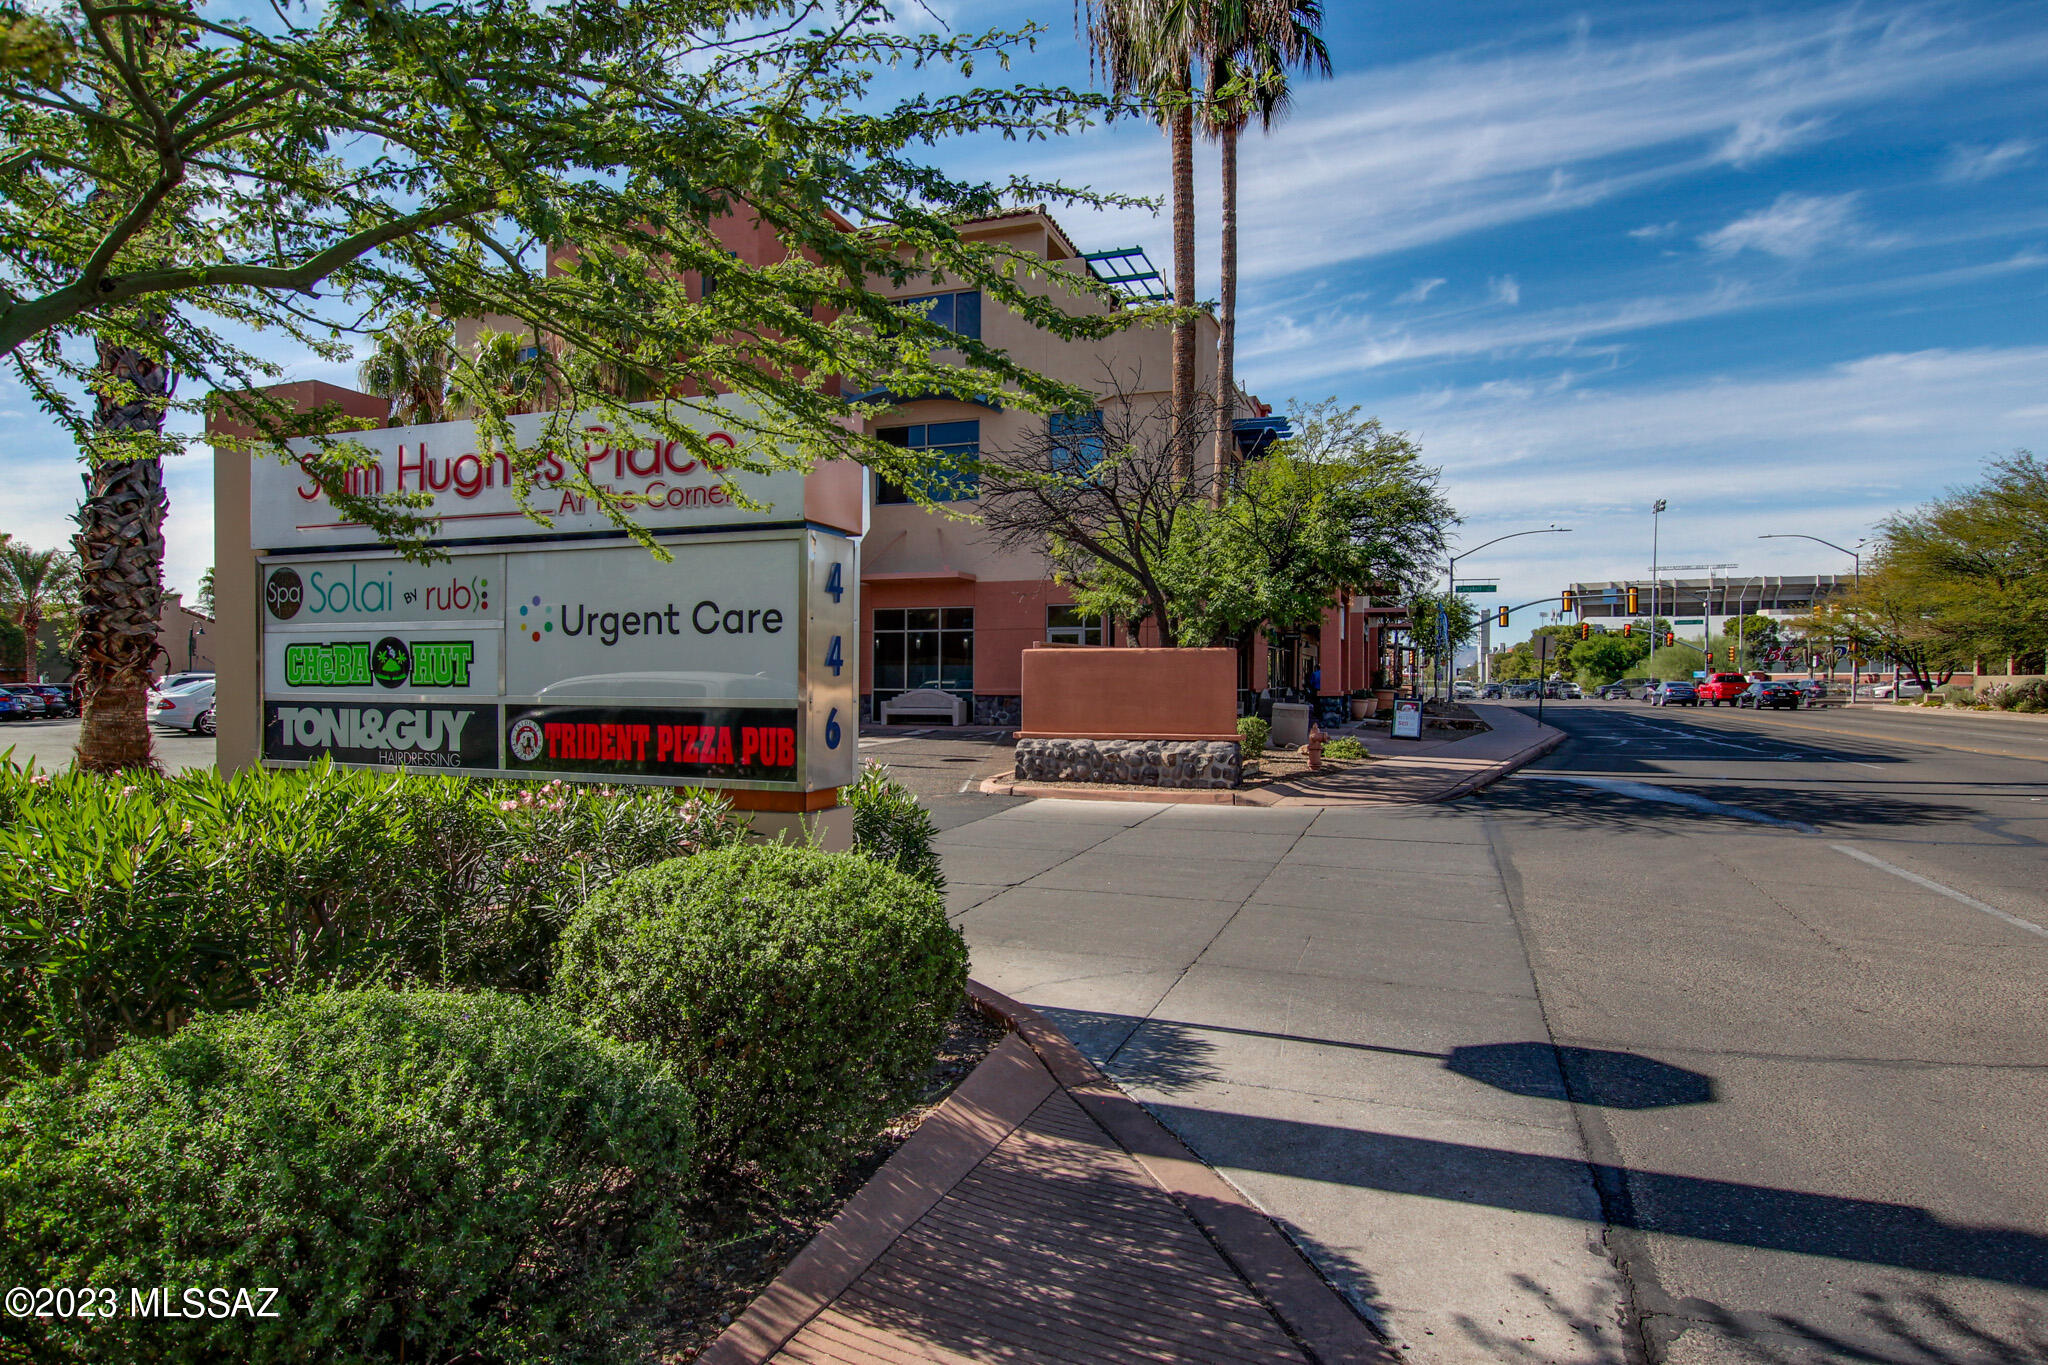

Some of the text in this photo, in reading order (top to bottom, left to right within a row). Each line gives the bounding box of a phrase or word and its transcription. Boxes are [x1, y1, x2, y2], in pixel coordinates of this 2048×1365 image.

[267, 582, 301, 612] Spa
[309, 563, 393, 614] Solai
[561, 600, 783, 646] Urgent Care
[411, 641, 475, 687] HUT
[277, 707, 471, 752] TONI&GUY
[544, 722, 796, 767] TRIDENT PIZZA PUB
[378, 750, 461, 767] HAIRDRESSING
